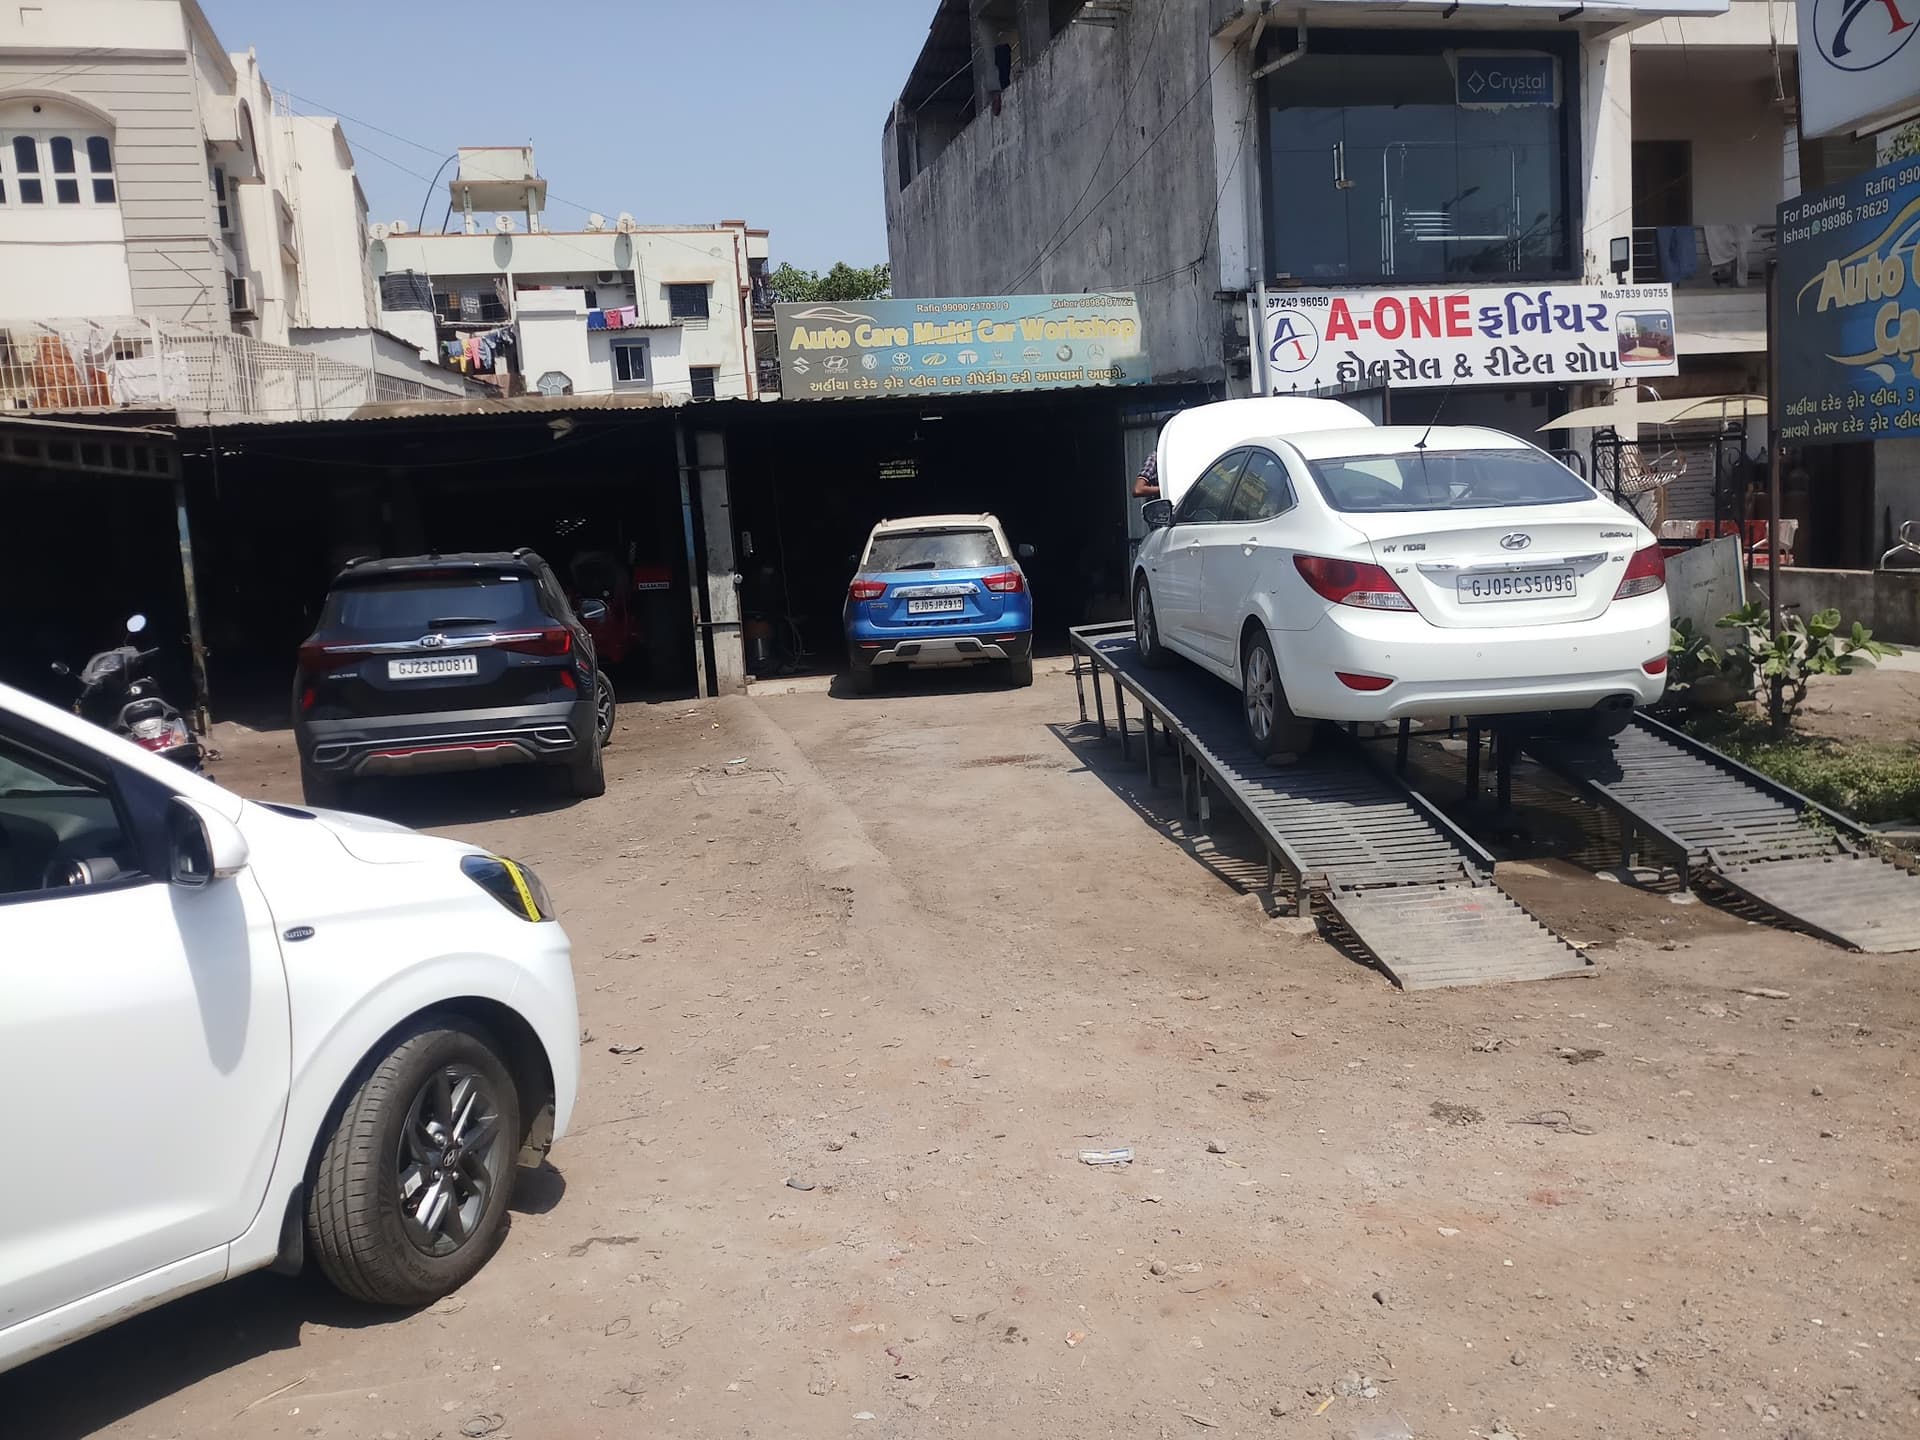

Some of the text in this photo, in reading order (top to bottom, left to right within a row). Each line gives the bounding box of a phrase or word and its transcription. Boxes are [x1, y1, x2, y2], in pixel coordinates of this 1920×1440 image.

[1488, 71, 1546, 94] Crystal
[1865, 176, 1895, 197] Rafiq
[1783, 194, 1846, 224] For Booking
[1783, 198, 1889, 244] Ishaq 98986 78629
[1816, 250, 1905, 312] Auto
[1300, 296, 1329, 307] 96050
[1600, 288, 1669, 299] Mo.97839 09755
[916, 303, 940, 313] Rafiq
[1325, 290, 1609, 341] A-ONE ફર્નિચર
[789, 314, 1137, 350] Auto Care Multi Car Workshop
[1336, 342, 1620, 383] હોલસેલ & રીટેલ શોપ
[853, 376, 878, 390] દરેક
[883, 375, 904, 390] ફોર
[909, 374, 937, 388] વ્હીલ
[942, 371, 962, 386] કાર
[1011, 369, 1031, 383] કરી
[1821, 393, 1841, 411] દરેક
[1847, 390, 1865, 410] ફોર
[1781, 420, 1809, 438] આવશે
[1813, 418, 1838, 435] તેમજ
[1842, 415, 1864, 432] દરેક
[1869, 412, 1888, 432] ફોર
[1472, 574, 1573, 597] GJ05CS5096
[399, 658, 473, 674] GJ23CD0811
